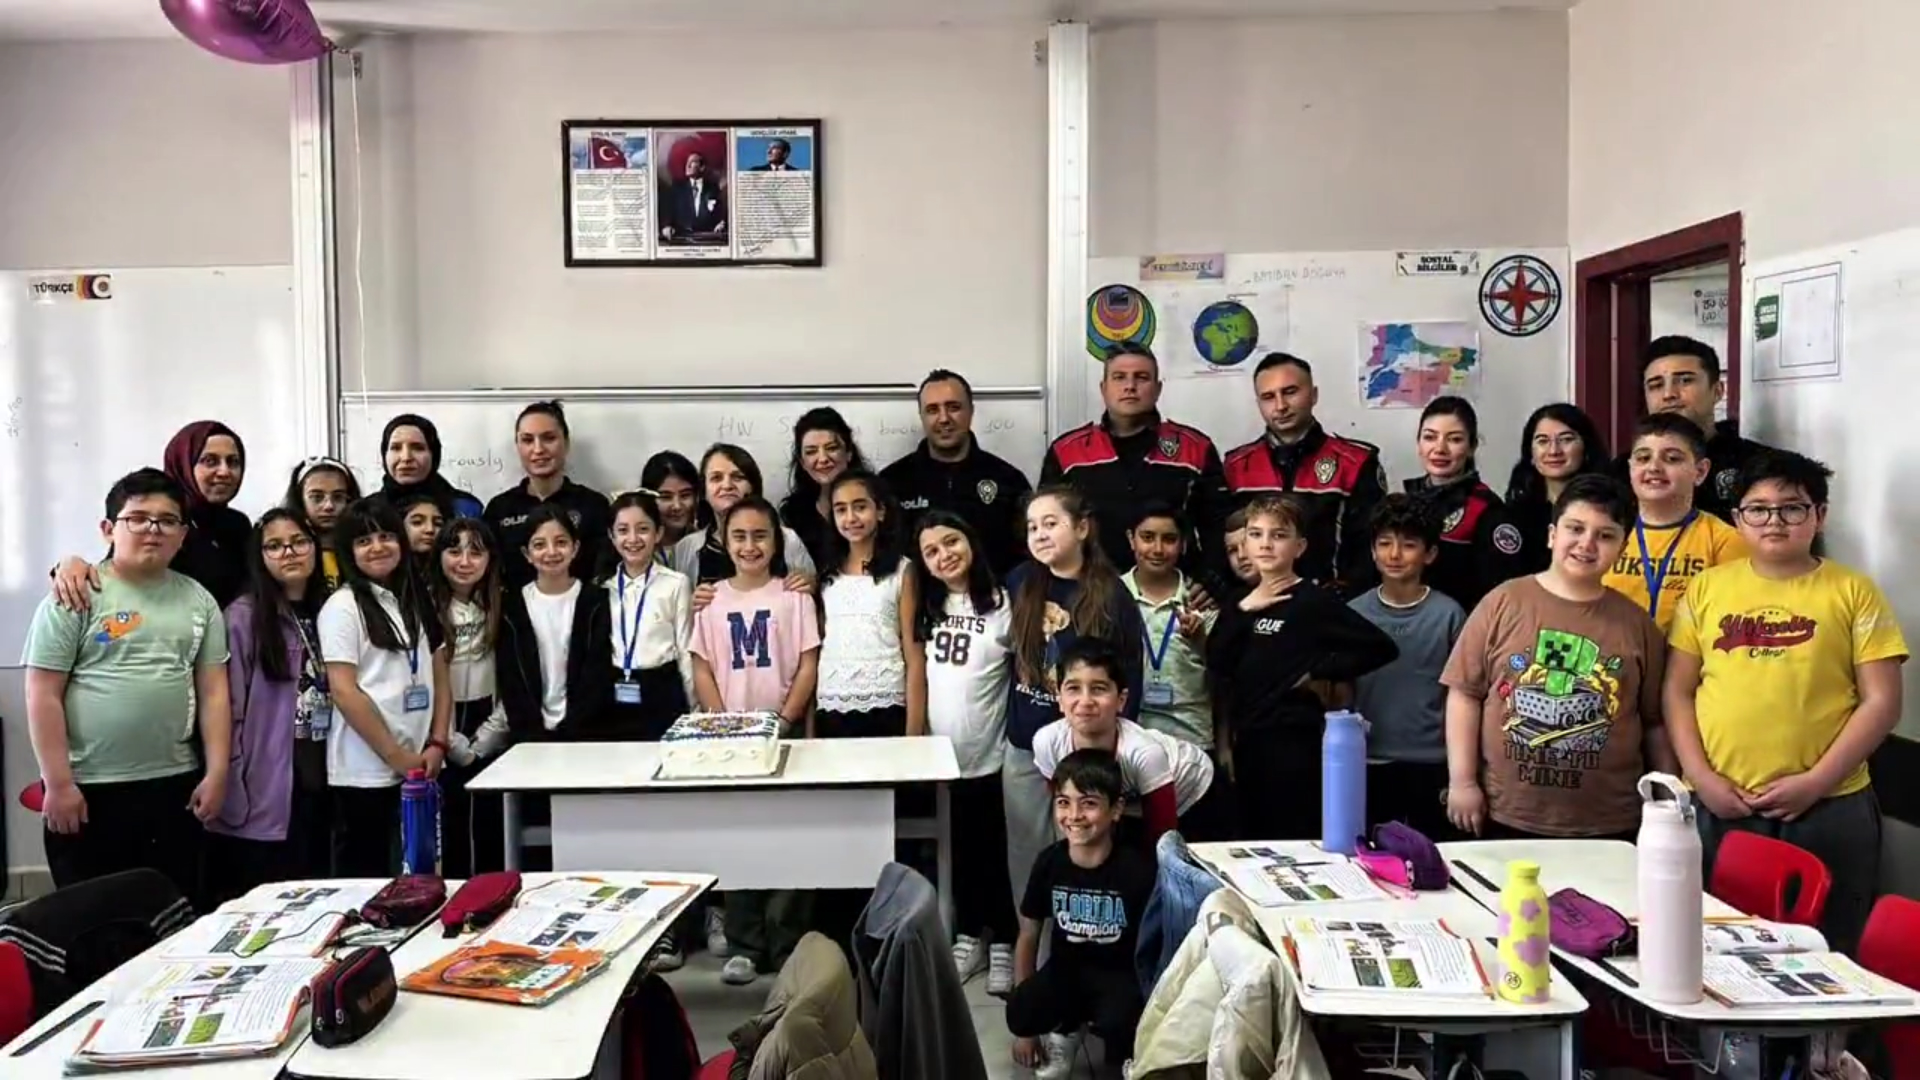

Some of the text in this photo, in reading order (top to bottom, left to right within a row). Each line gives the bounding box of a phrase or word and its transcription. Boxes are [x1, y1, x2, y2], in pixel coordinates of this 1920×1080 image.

[33, 281, 75, 294] TÜRKÇE
[727, 609, 772, 670] M
[934, 631, 972, 667] 98
[1518, 763, 1583, 789] MINE
[1052, 889, 1128, 928] FLORIDA
